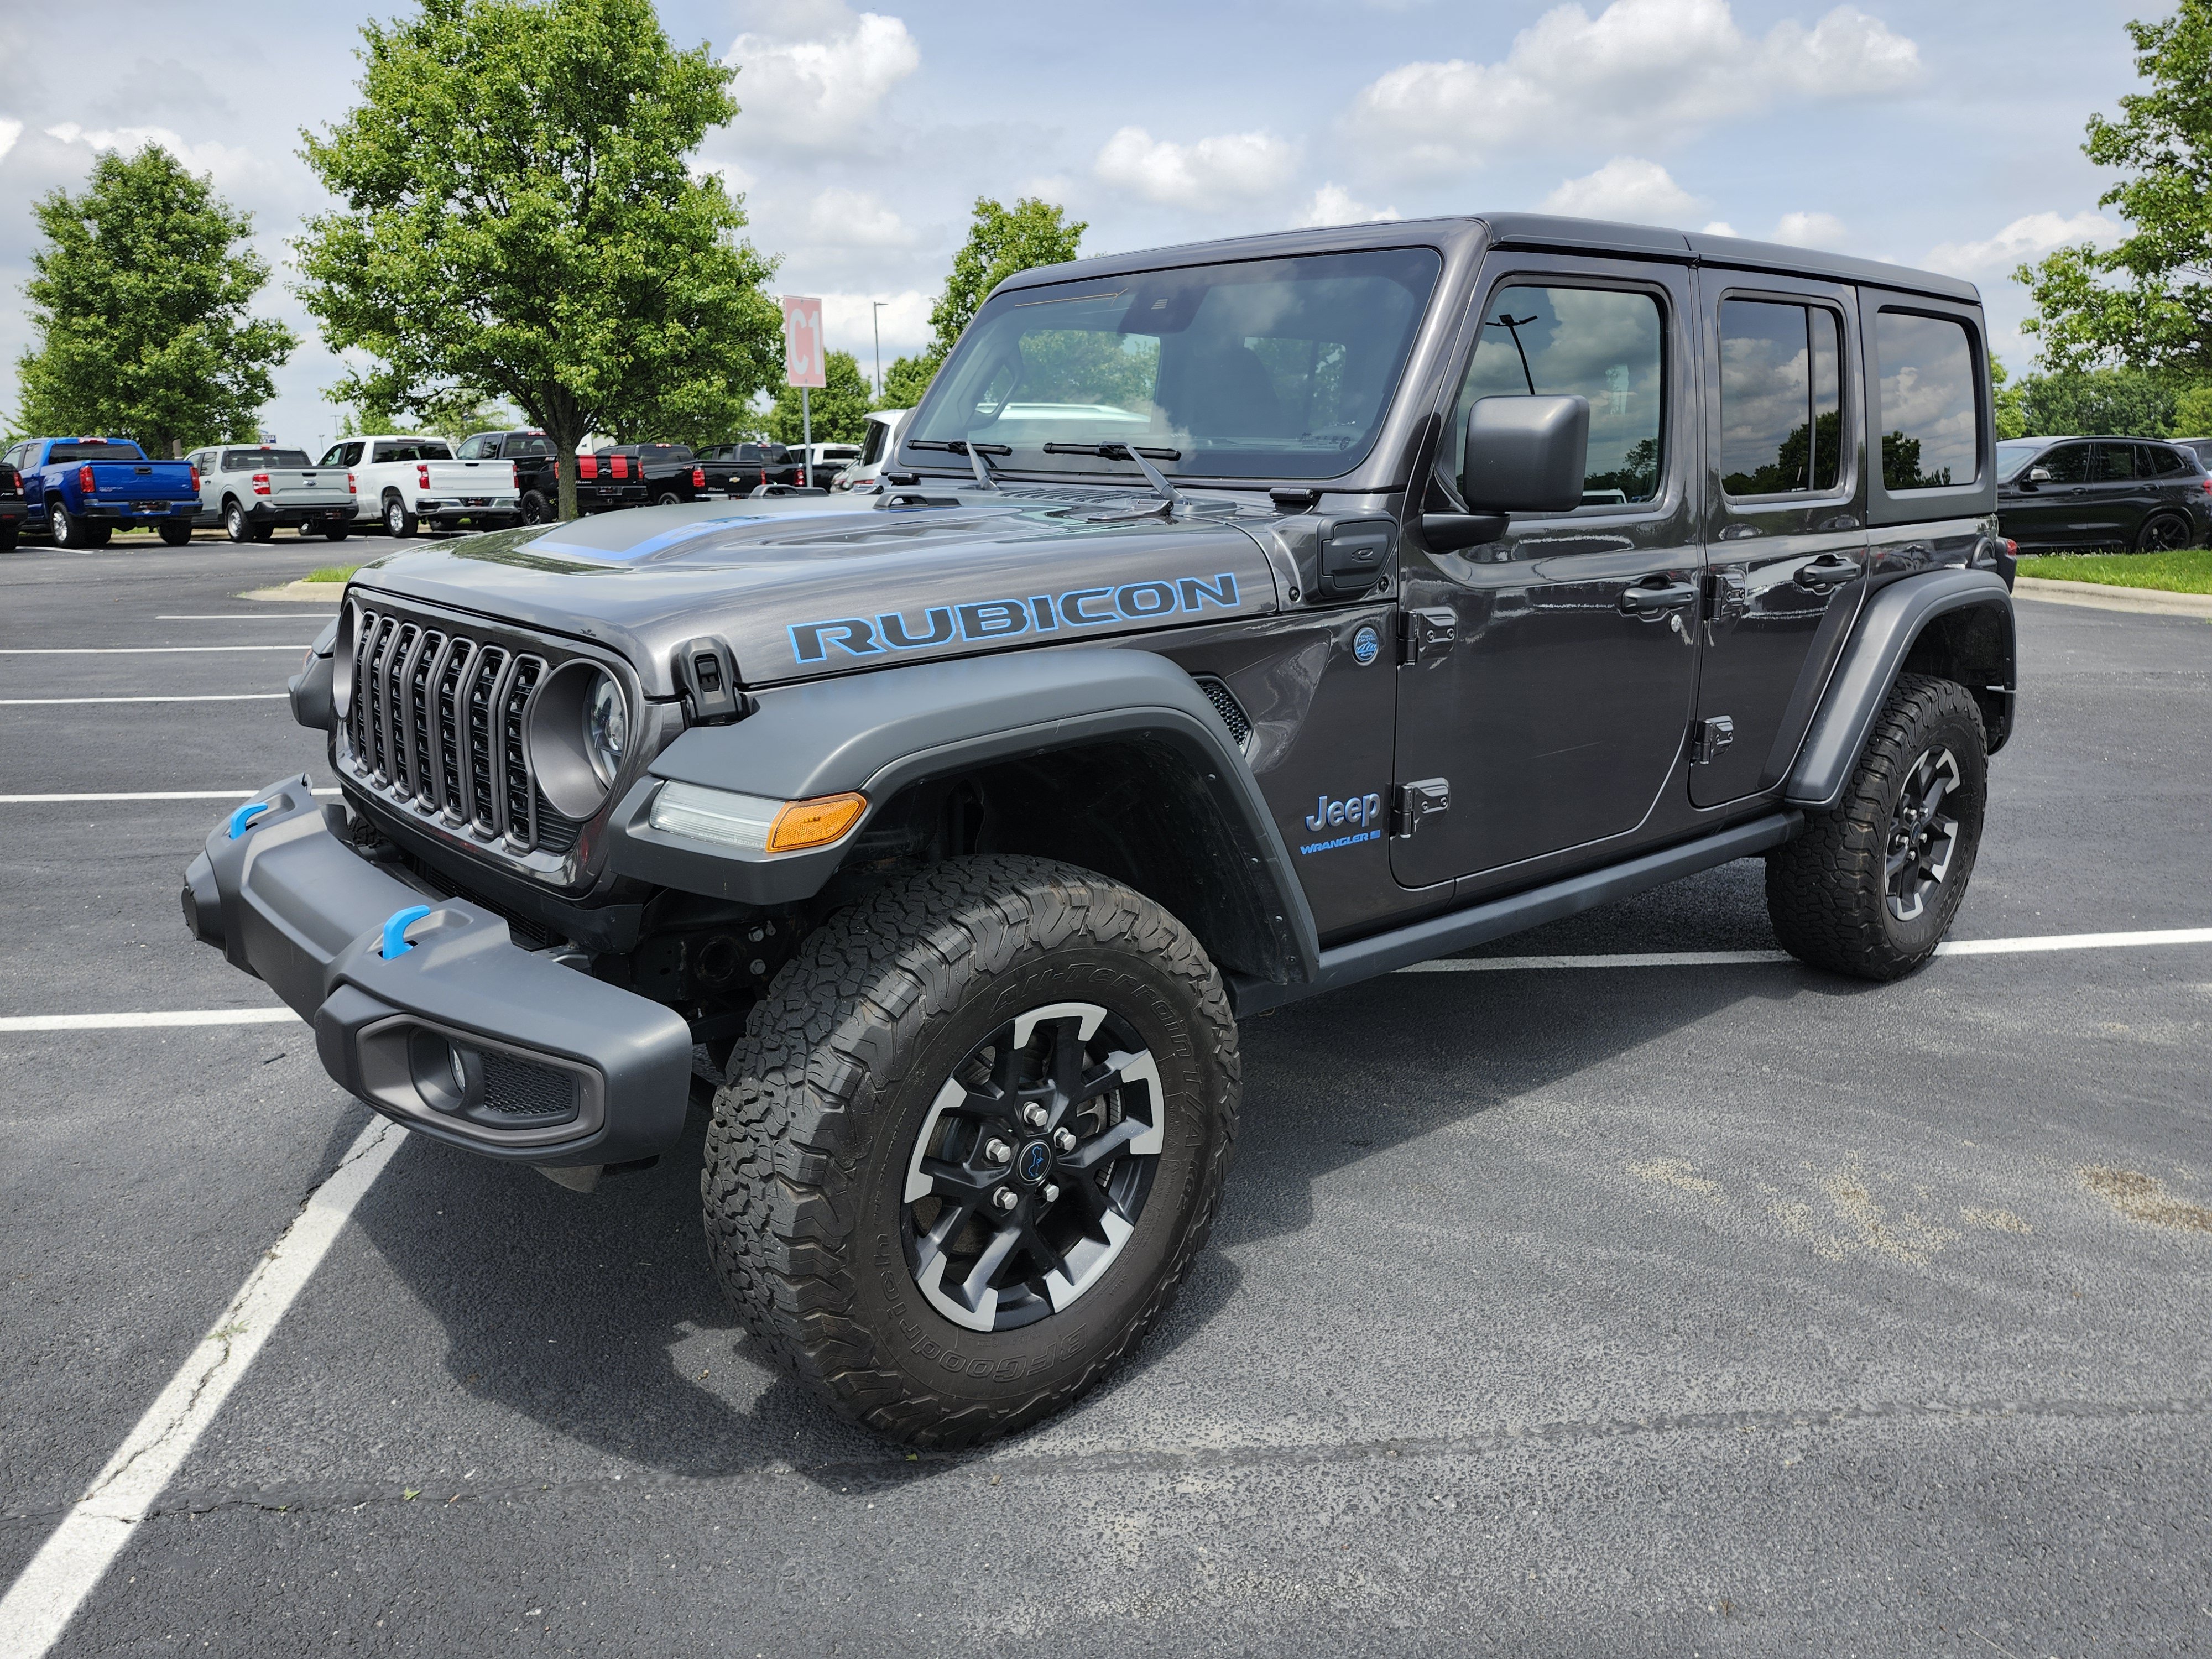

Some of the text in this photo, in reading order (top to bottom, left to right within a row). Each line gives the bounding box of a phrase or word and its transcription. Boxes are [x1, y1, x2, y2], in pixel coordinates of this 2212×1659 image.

[789, 308, 822, 375] C1
[786, 572, 1241, 665] RUBICON
[1300, 832, 1369, 855] WRANGLER
[1305, 792, 1381, 832] Jeep
[989, 962, 1193, 1058] All-Terrain
[874, 1233, 1088, 1383] BFGoodrich
